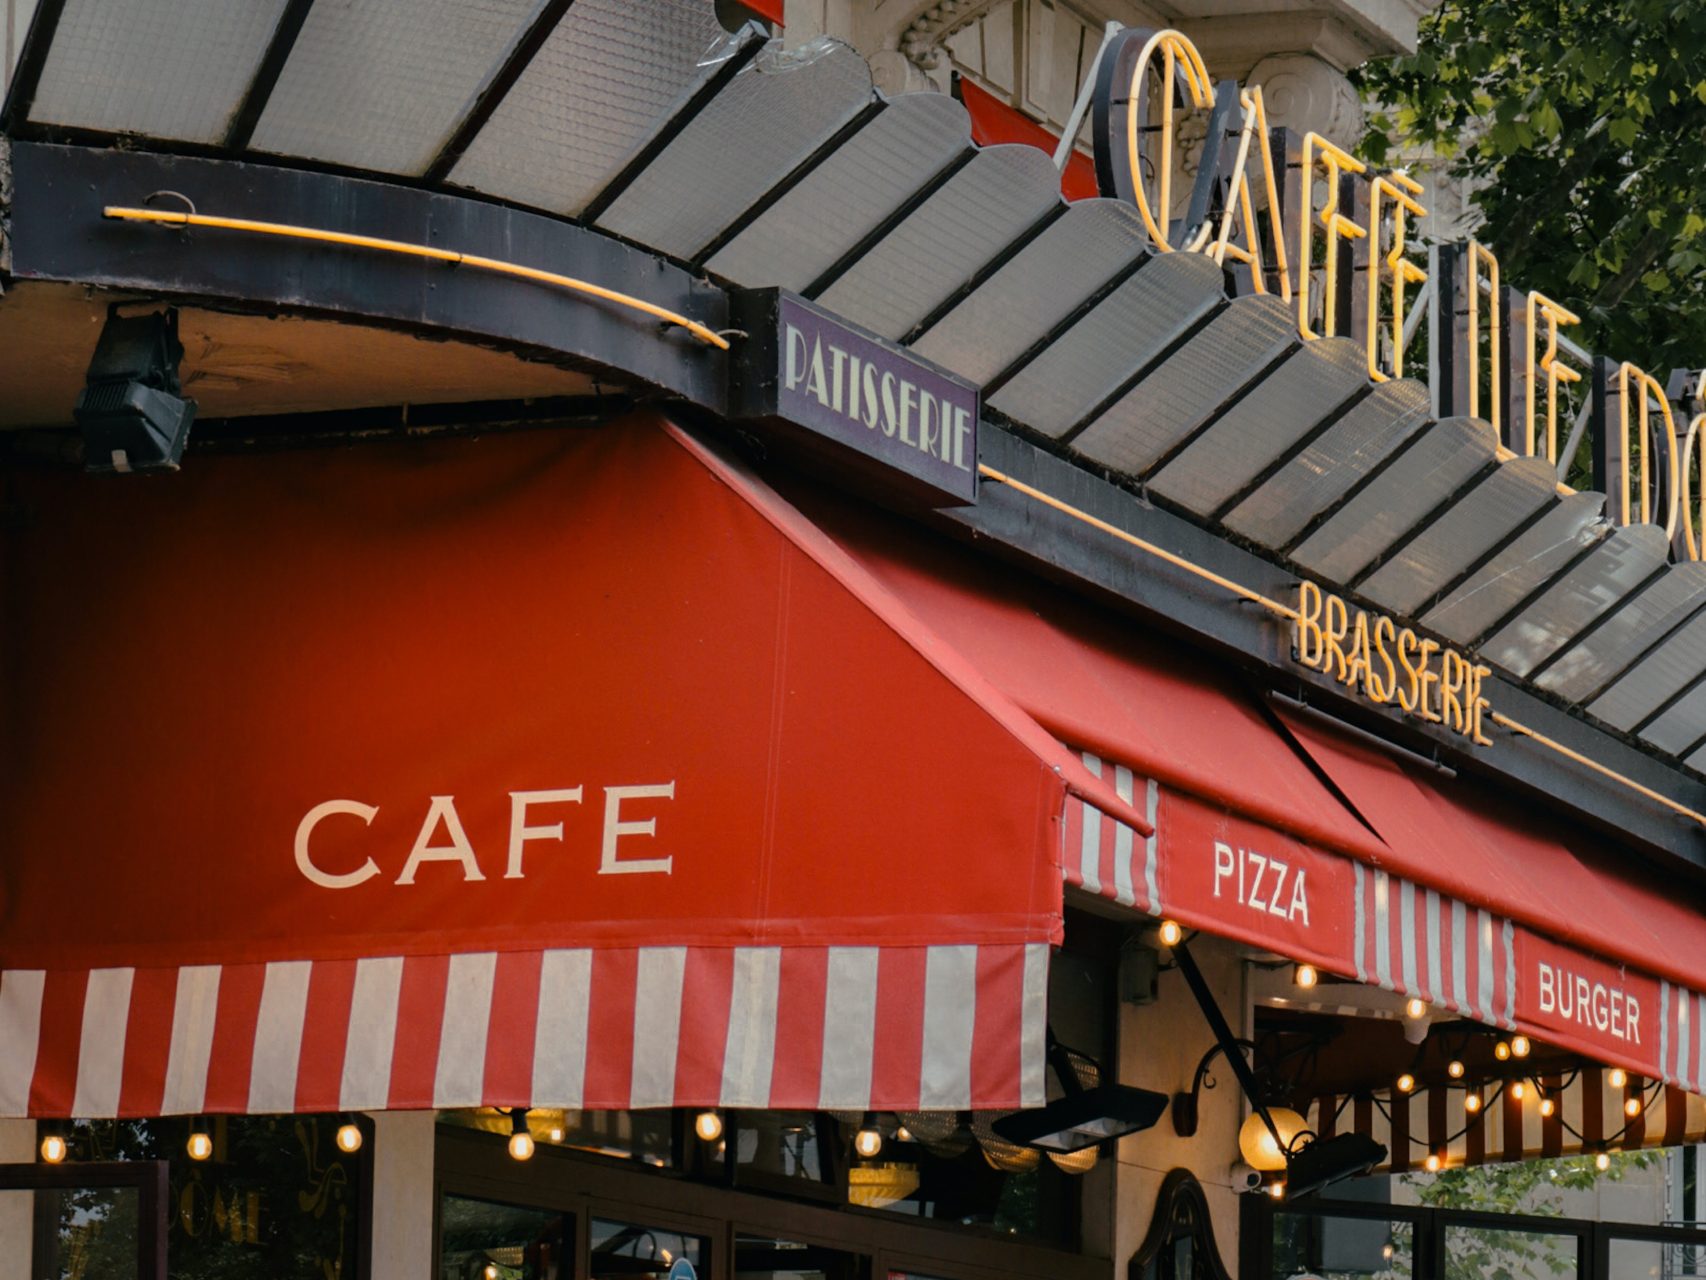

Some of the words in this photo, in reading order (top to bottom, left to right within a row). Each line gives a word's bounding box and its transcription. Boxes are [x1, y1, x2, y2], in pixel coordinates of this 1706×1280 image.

[784, 321, 972, 473] PATISSERIE
[1467, 239, 1582, 496] LE
[1300, 578, 1494, 747] BRASSERIE
[293, 779, 677, 890] CAFE
[1213, 840, 1310, 929] PIZZA
[1538, 965, 1641, 1045] BURGER
